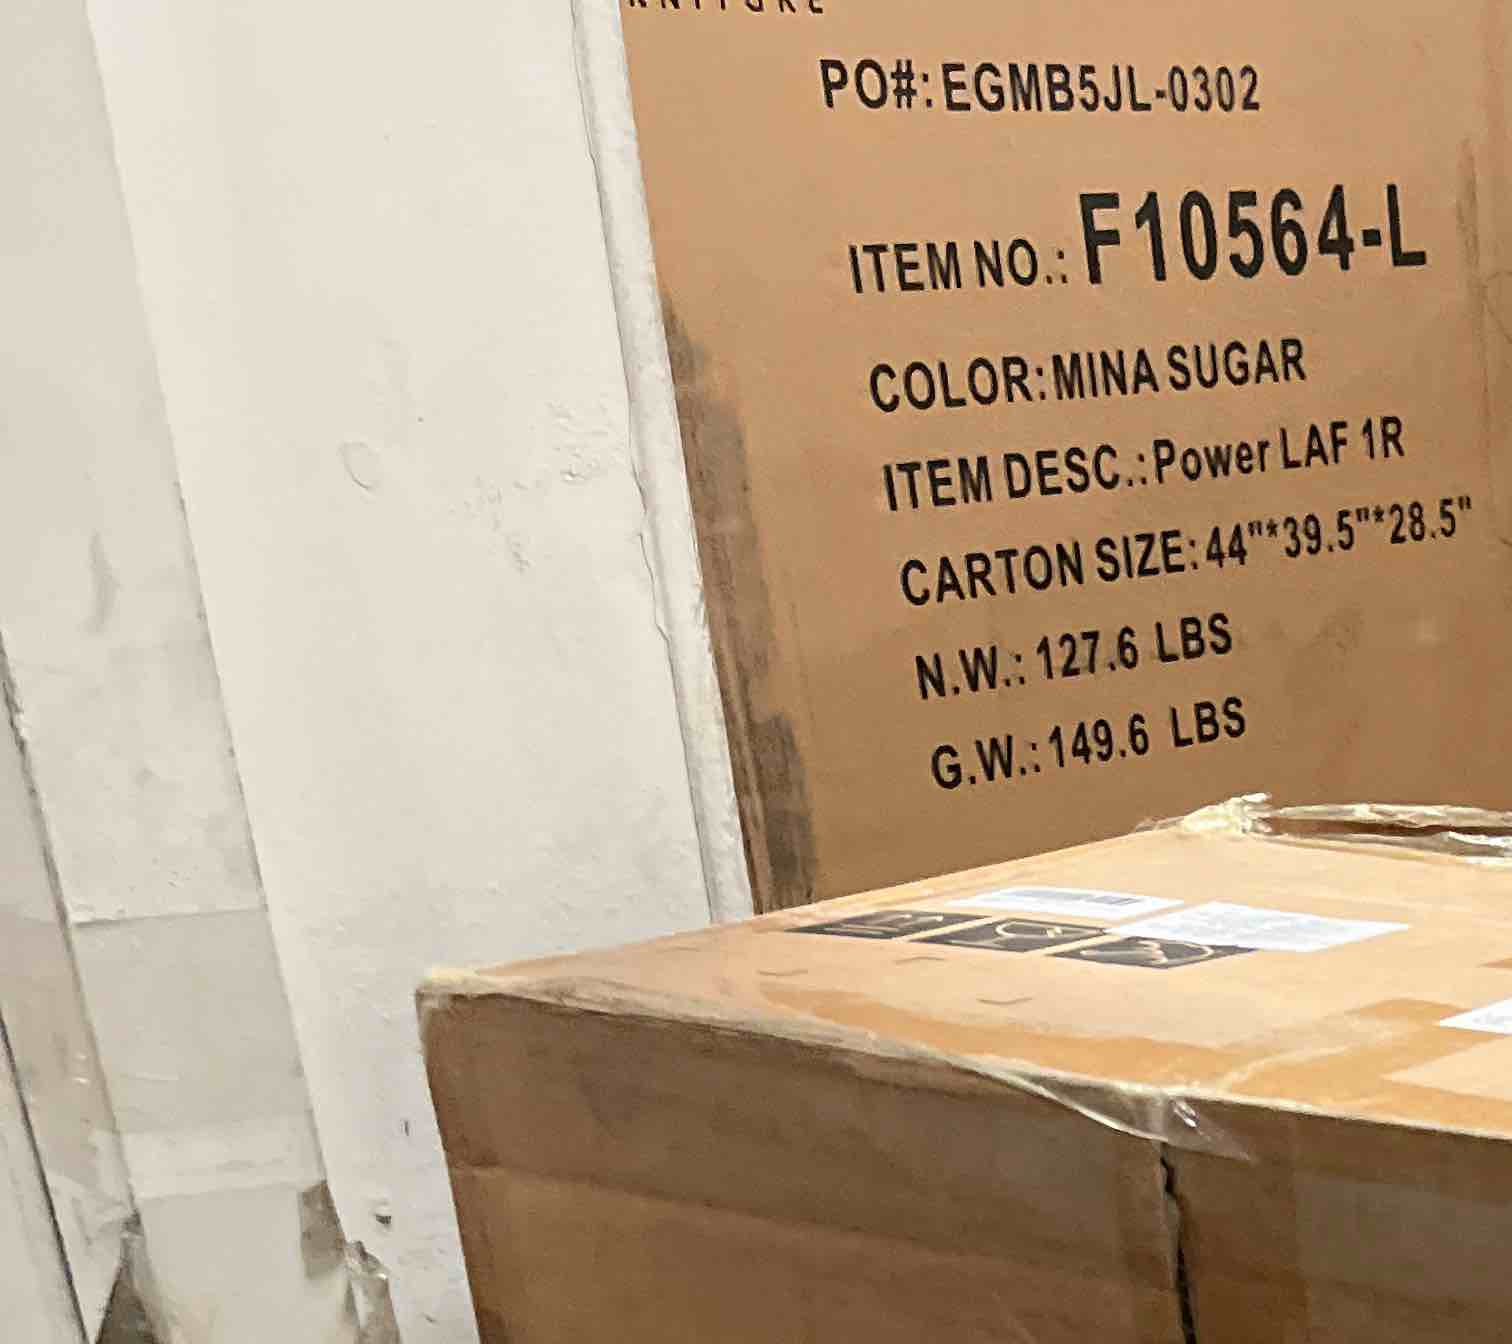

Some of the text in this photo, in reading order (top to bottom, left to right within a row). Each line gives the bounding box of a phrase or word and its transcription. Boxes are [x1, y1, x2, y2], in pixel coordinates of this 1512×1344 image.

[848, 182, 1428, 295] ITEM NO.: F10564-L
[1166, 337, 1308, 392] SUGAR
[882, 454, 994, 513] ITEM
[1278, 419, 1349, 471] LAF
[1359, 414, 1406, 461] 1R
[899, 539, 1085, 607] CARTON
[1035, 624, 1140, 681] 127.6
[1153, 611, 1234, 664] LBS
[1168, 695, 1247, 749] LBS
